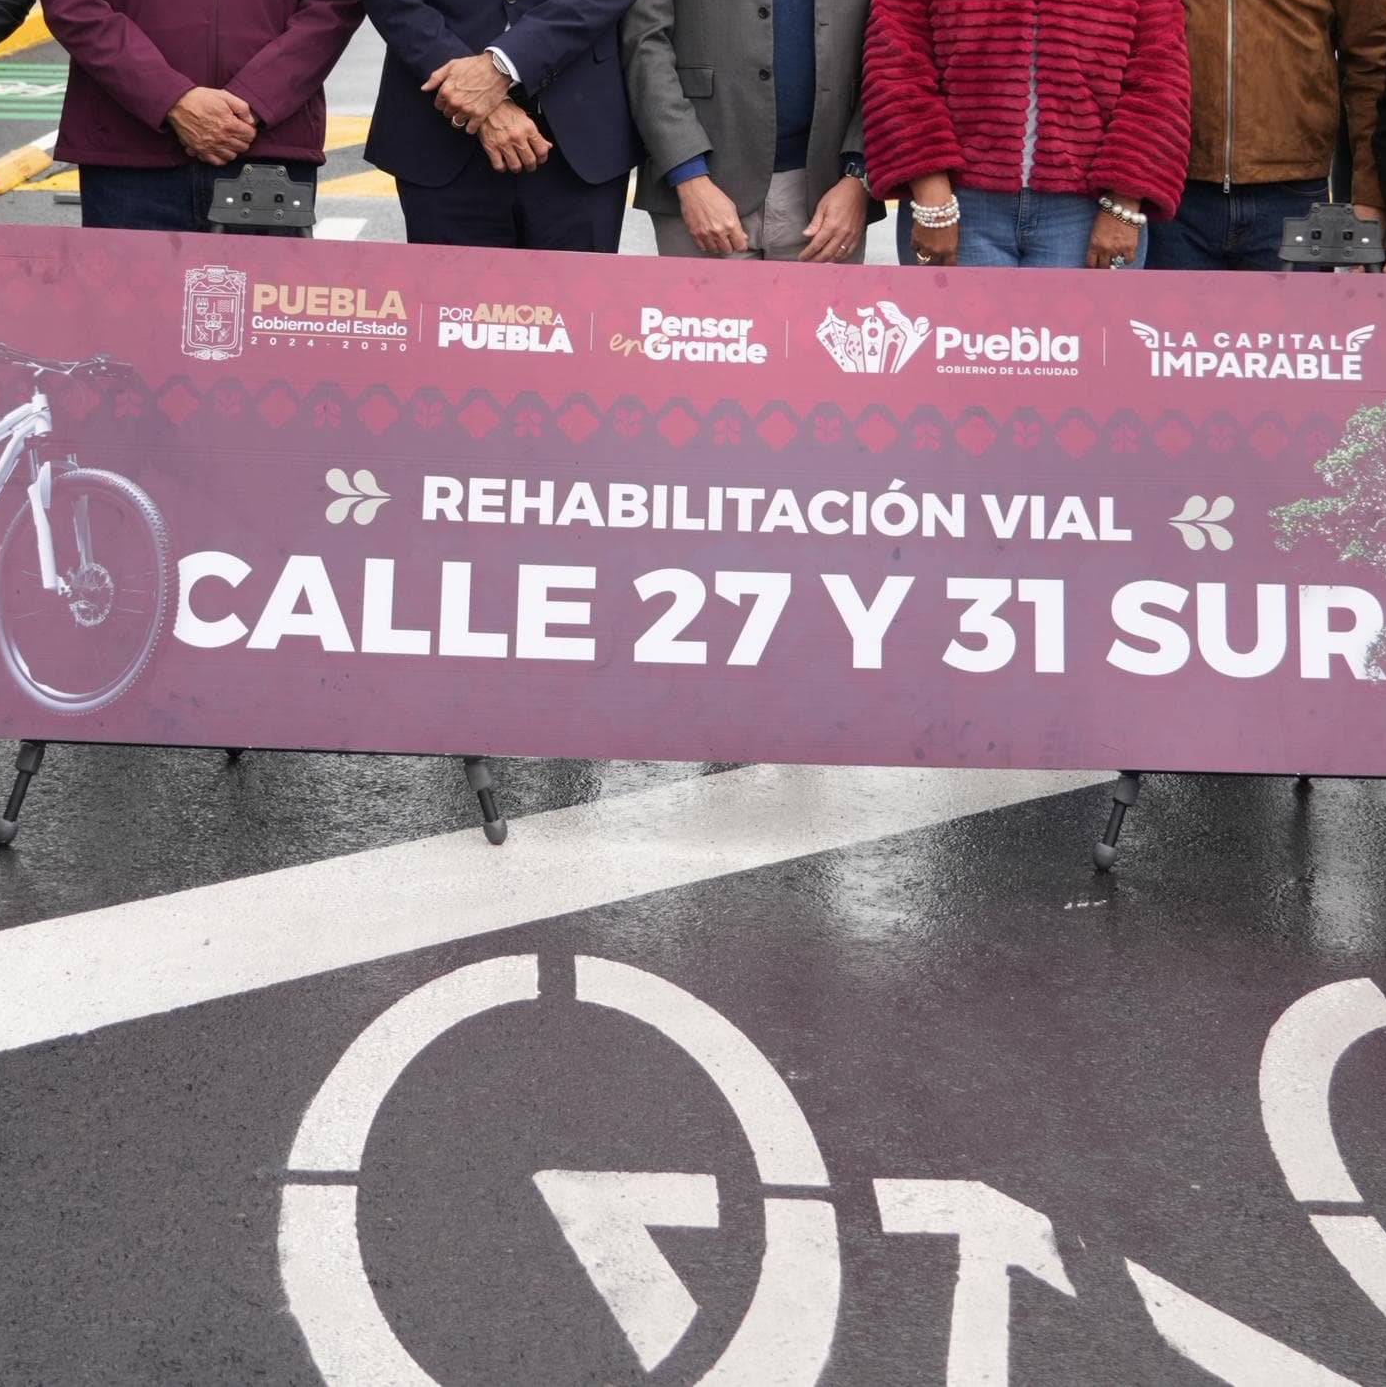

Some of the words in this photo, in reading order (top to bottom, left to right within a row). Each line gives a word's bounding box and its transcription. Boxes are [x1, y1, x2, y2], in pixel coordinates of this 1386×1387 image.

[251, 282, 408, 320] PUEBLA
[251, 315, 324, 333] Gobierno
[326, 318, 350, 334] del
[352, 320, 408, 336] Estado
[437, 321, 574, 353] PUEBLA
[640, 306, 754, 339] Pensar
[609, 332, 646, 357] en
[643, 331, 768, 364] Grande
[934, 325, 1080, 362] Puebla
[1164, 331, 1198, 348] LA
[1213, 331, 1344, 351] CAPITAL
[936, 365, 997, 375] GOBIERNO
[999, 366, 1014, 375] DE
[1016, 366, 1032, 376] LA
[1033, 366, 1079, 377] CIUDAD
[1150, 350, 1363, 381] IMPARABLE
[421, 475, 965, 538] REHABILITACIÓN
[981, 493, 1133, 541] VIAL
[172, 549, 598, 662] CALLE
[631, 566, 793, 666] 27
[819, 573, 916, 669] Y
[940, 575, 1066, 674] 31
